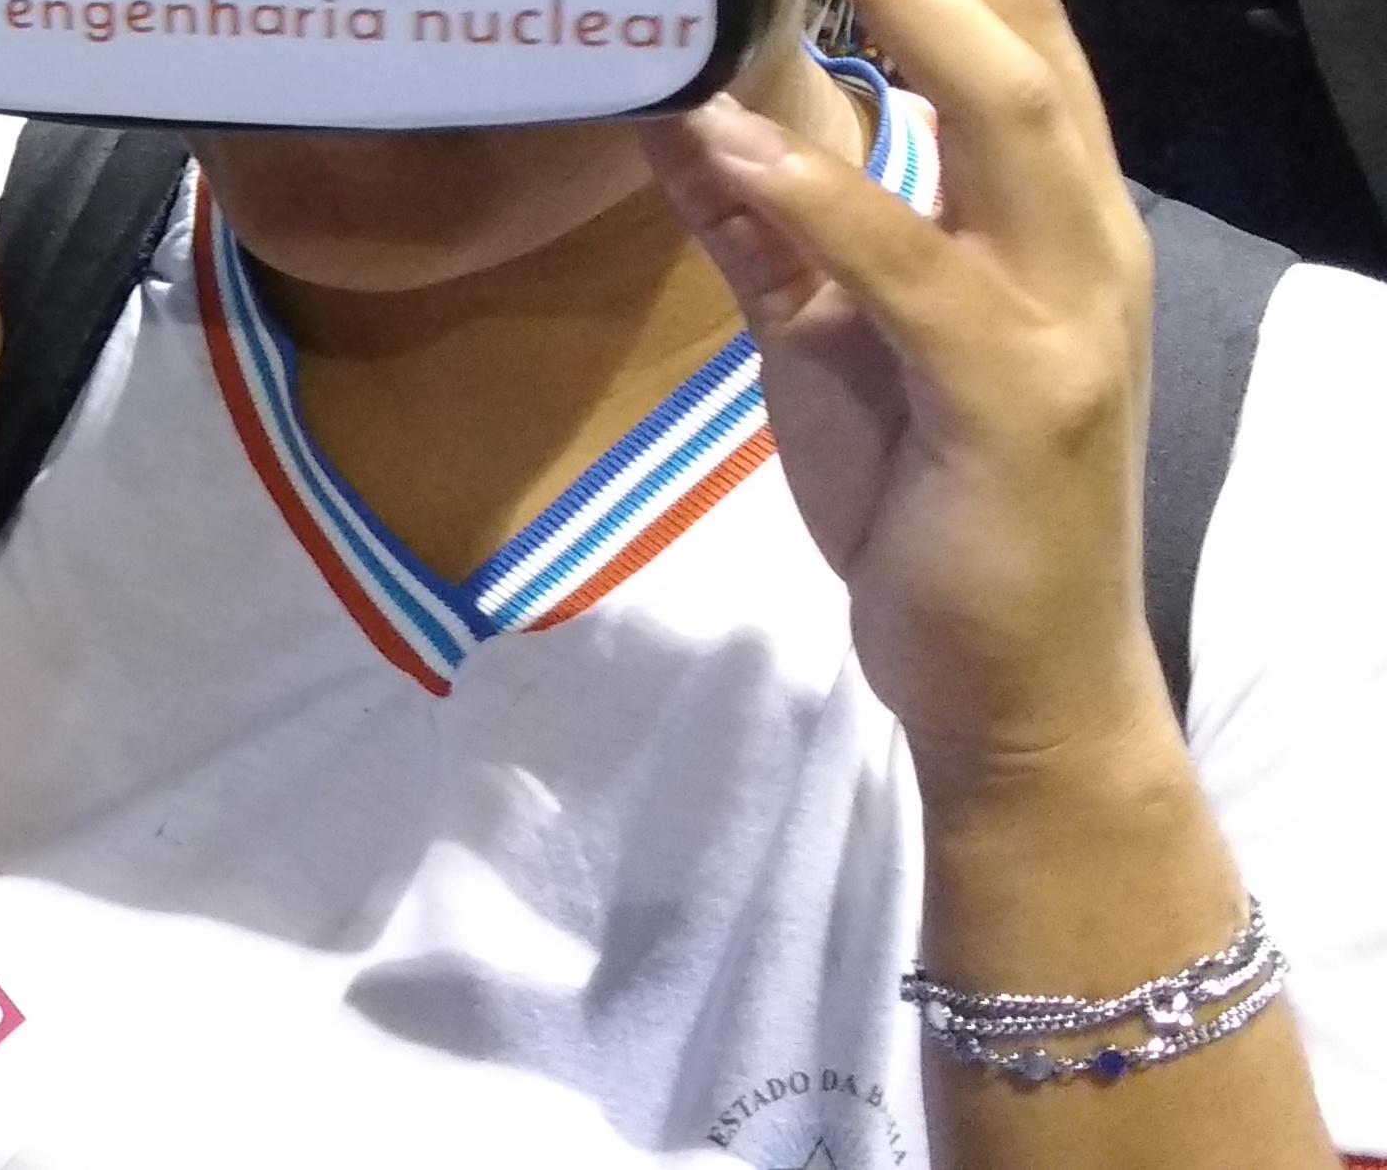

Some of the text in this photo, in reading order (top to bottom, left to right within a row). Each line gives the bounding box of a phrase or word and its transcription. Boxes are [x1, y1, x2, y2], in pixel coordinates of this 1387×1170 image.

[706, 1067, 908, 1168] ESTADO DA BIA
